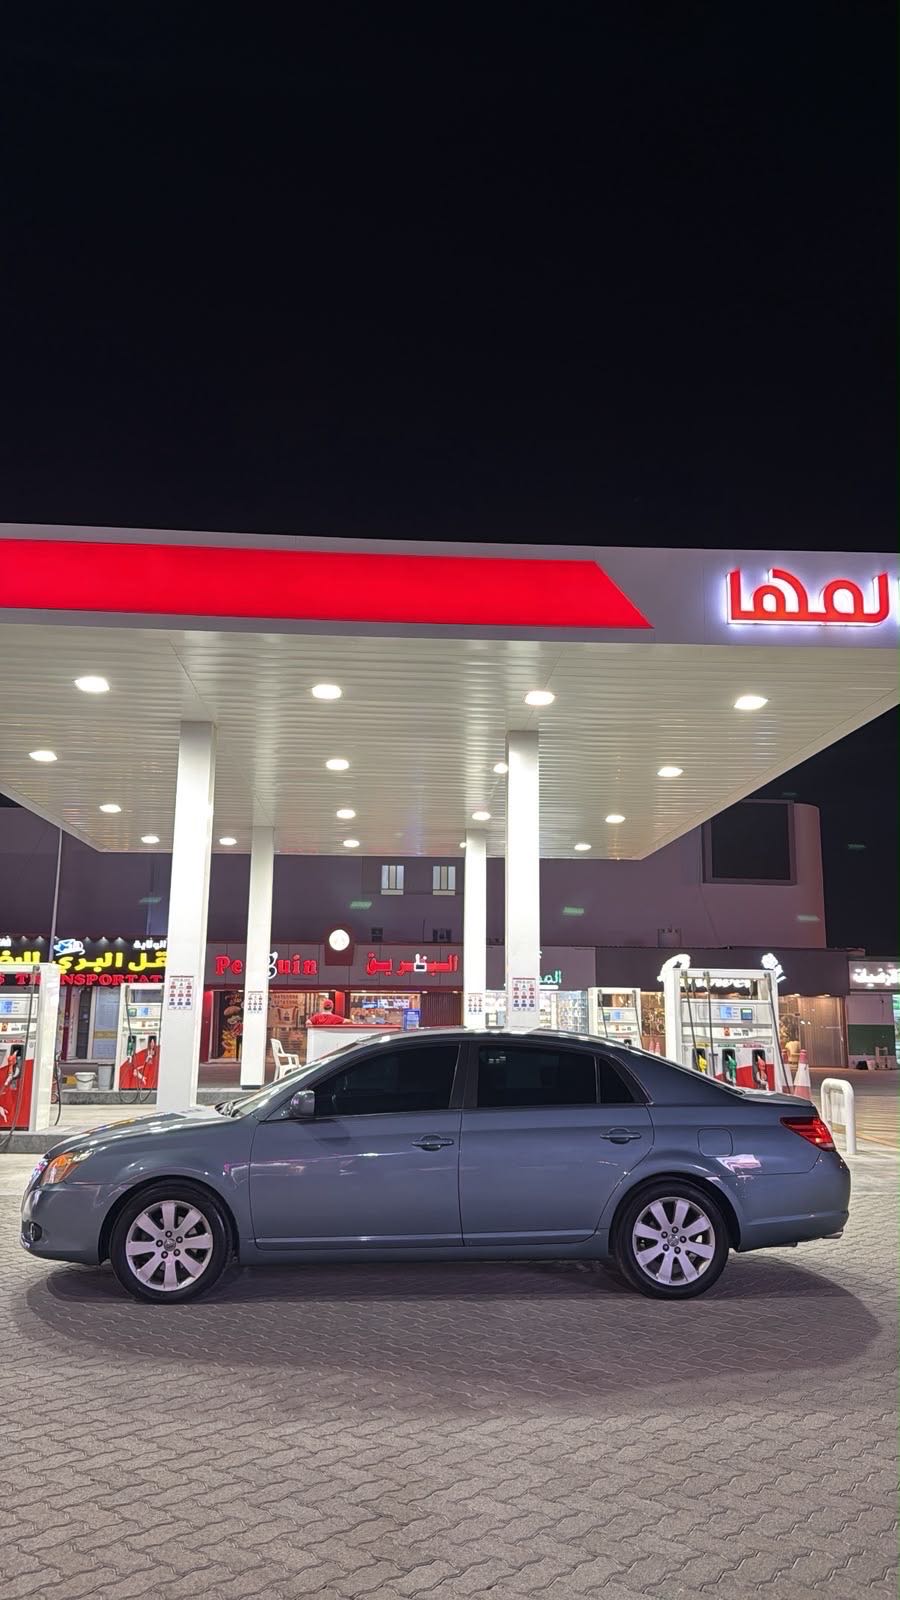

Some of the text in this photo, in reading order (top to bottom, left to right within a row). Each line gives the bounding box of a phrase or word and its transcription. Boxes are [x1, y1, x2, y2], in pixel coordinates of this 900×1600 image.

[727, 568, 900, 627] لمها
[128, 950, 168, 972] قل
[215, 951, 317, 979] Peguin
